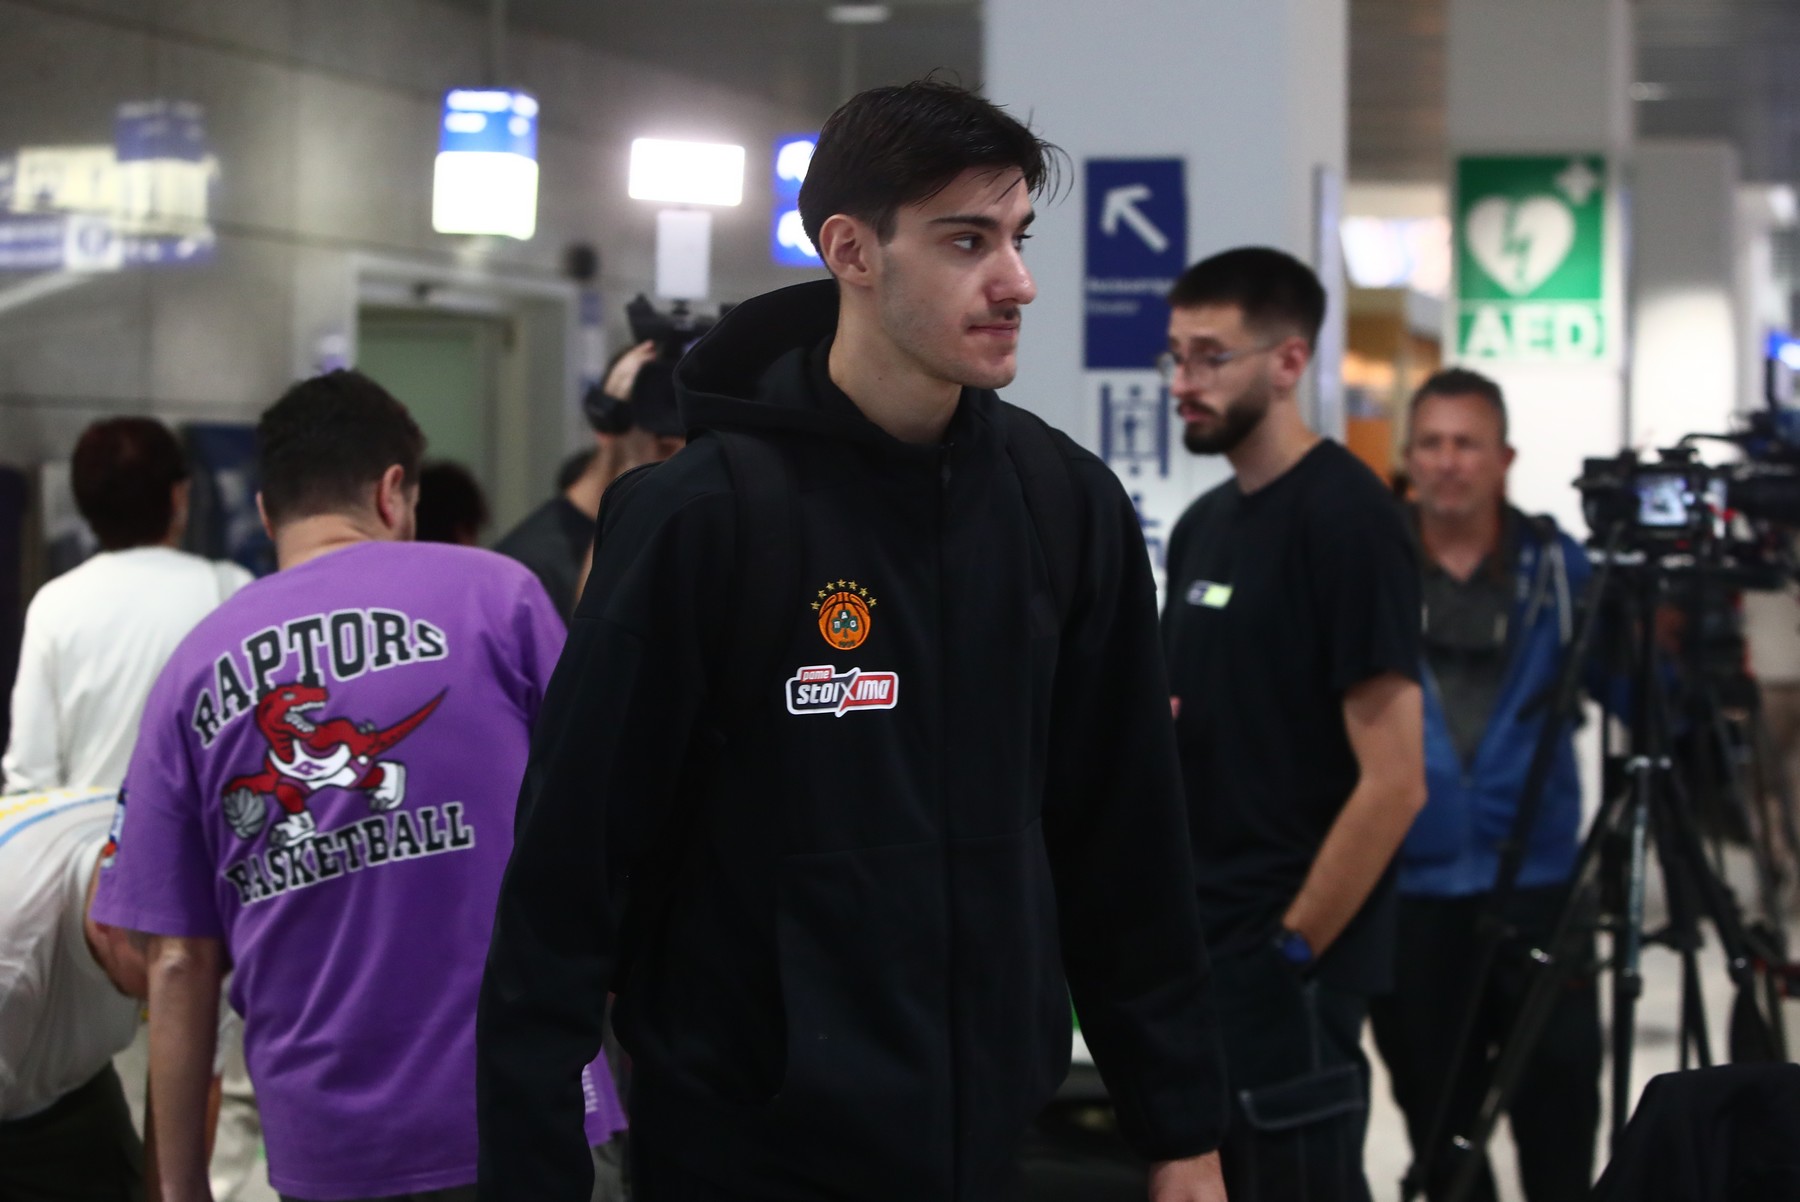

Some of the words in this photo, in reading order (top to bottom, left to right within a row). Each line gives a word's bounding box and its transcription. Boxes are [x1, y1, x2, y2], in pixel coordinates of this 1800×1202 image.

[1464, 303, 1602, 358] AED
[192, 608, 448, 748] RAPTORS
[223, 802, 474, 905] BASKETBALL
